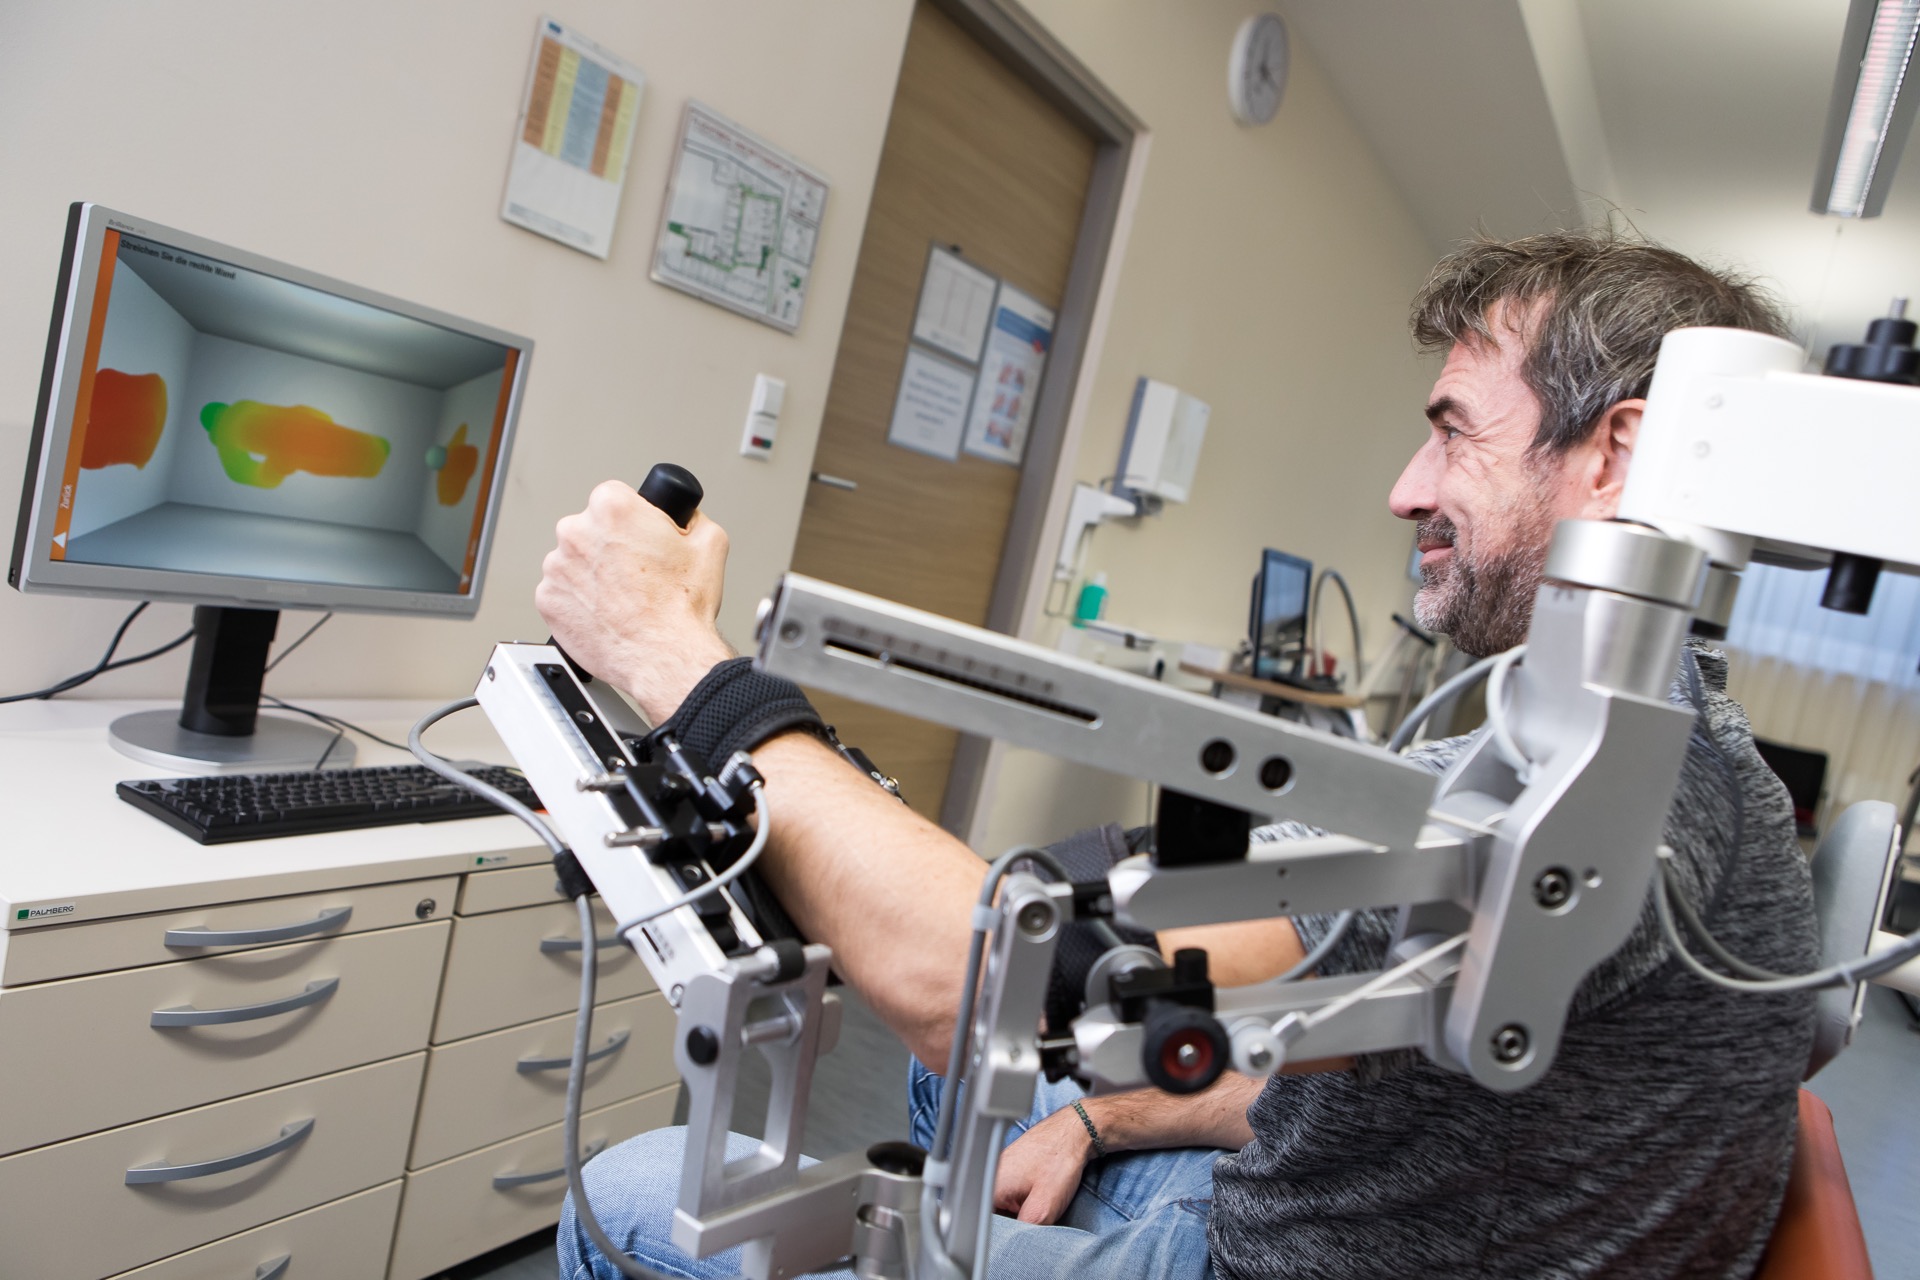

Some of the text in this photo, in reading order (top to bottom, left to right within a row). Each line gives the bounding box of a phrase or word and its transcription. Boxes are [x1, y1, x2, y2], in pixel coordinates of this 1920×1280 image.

[120, 239, 236, 280] Streichen Sie die rechte Wand
[30, 905, 74, 917] PALMBERG
